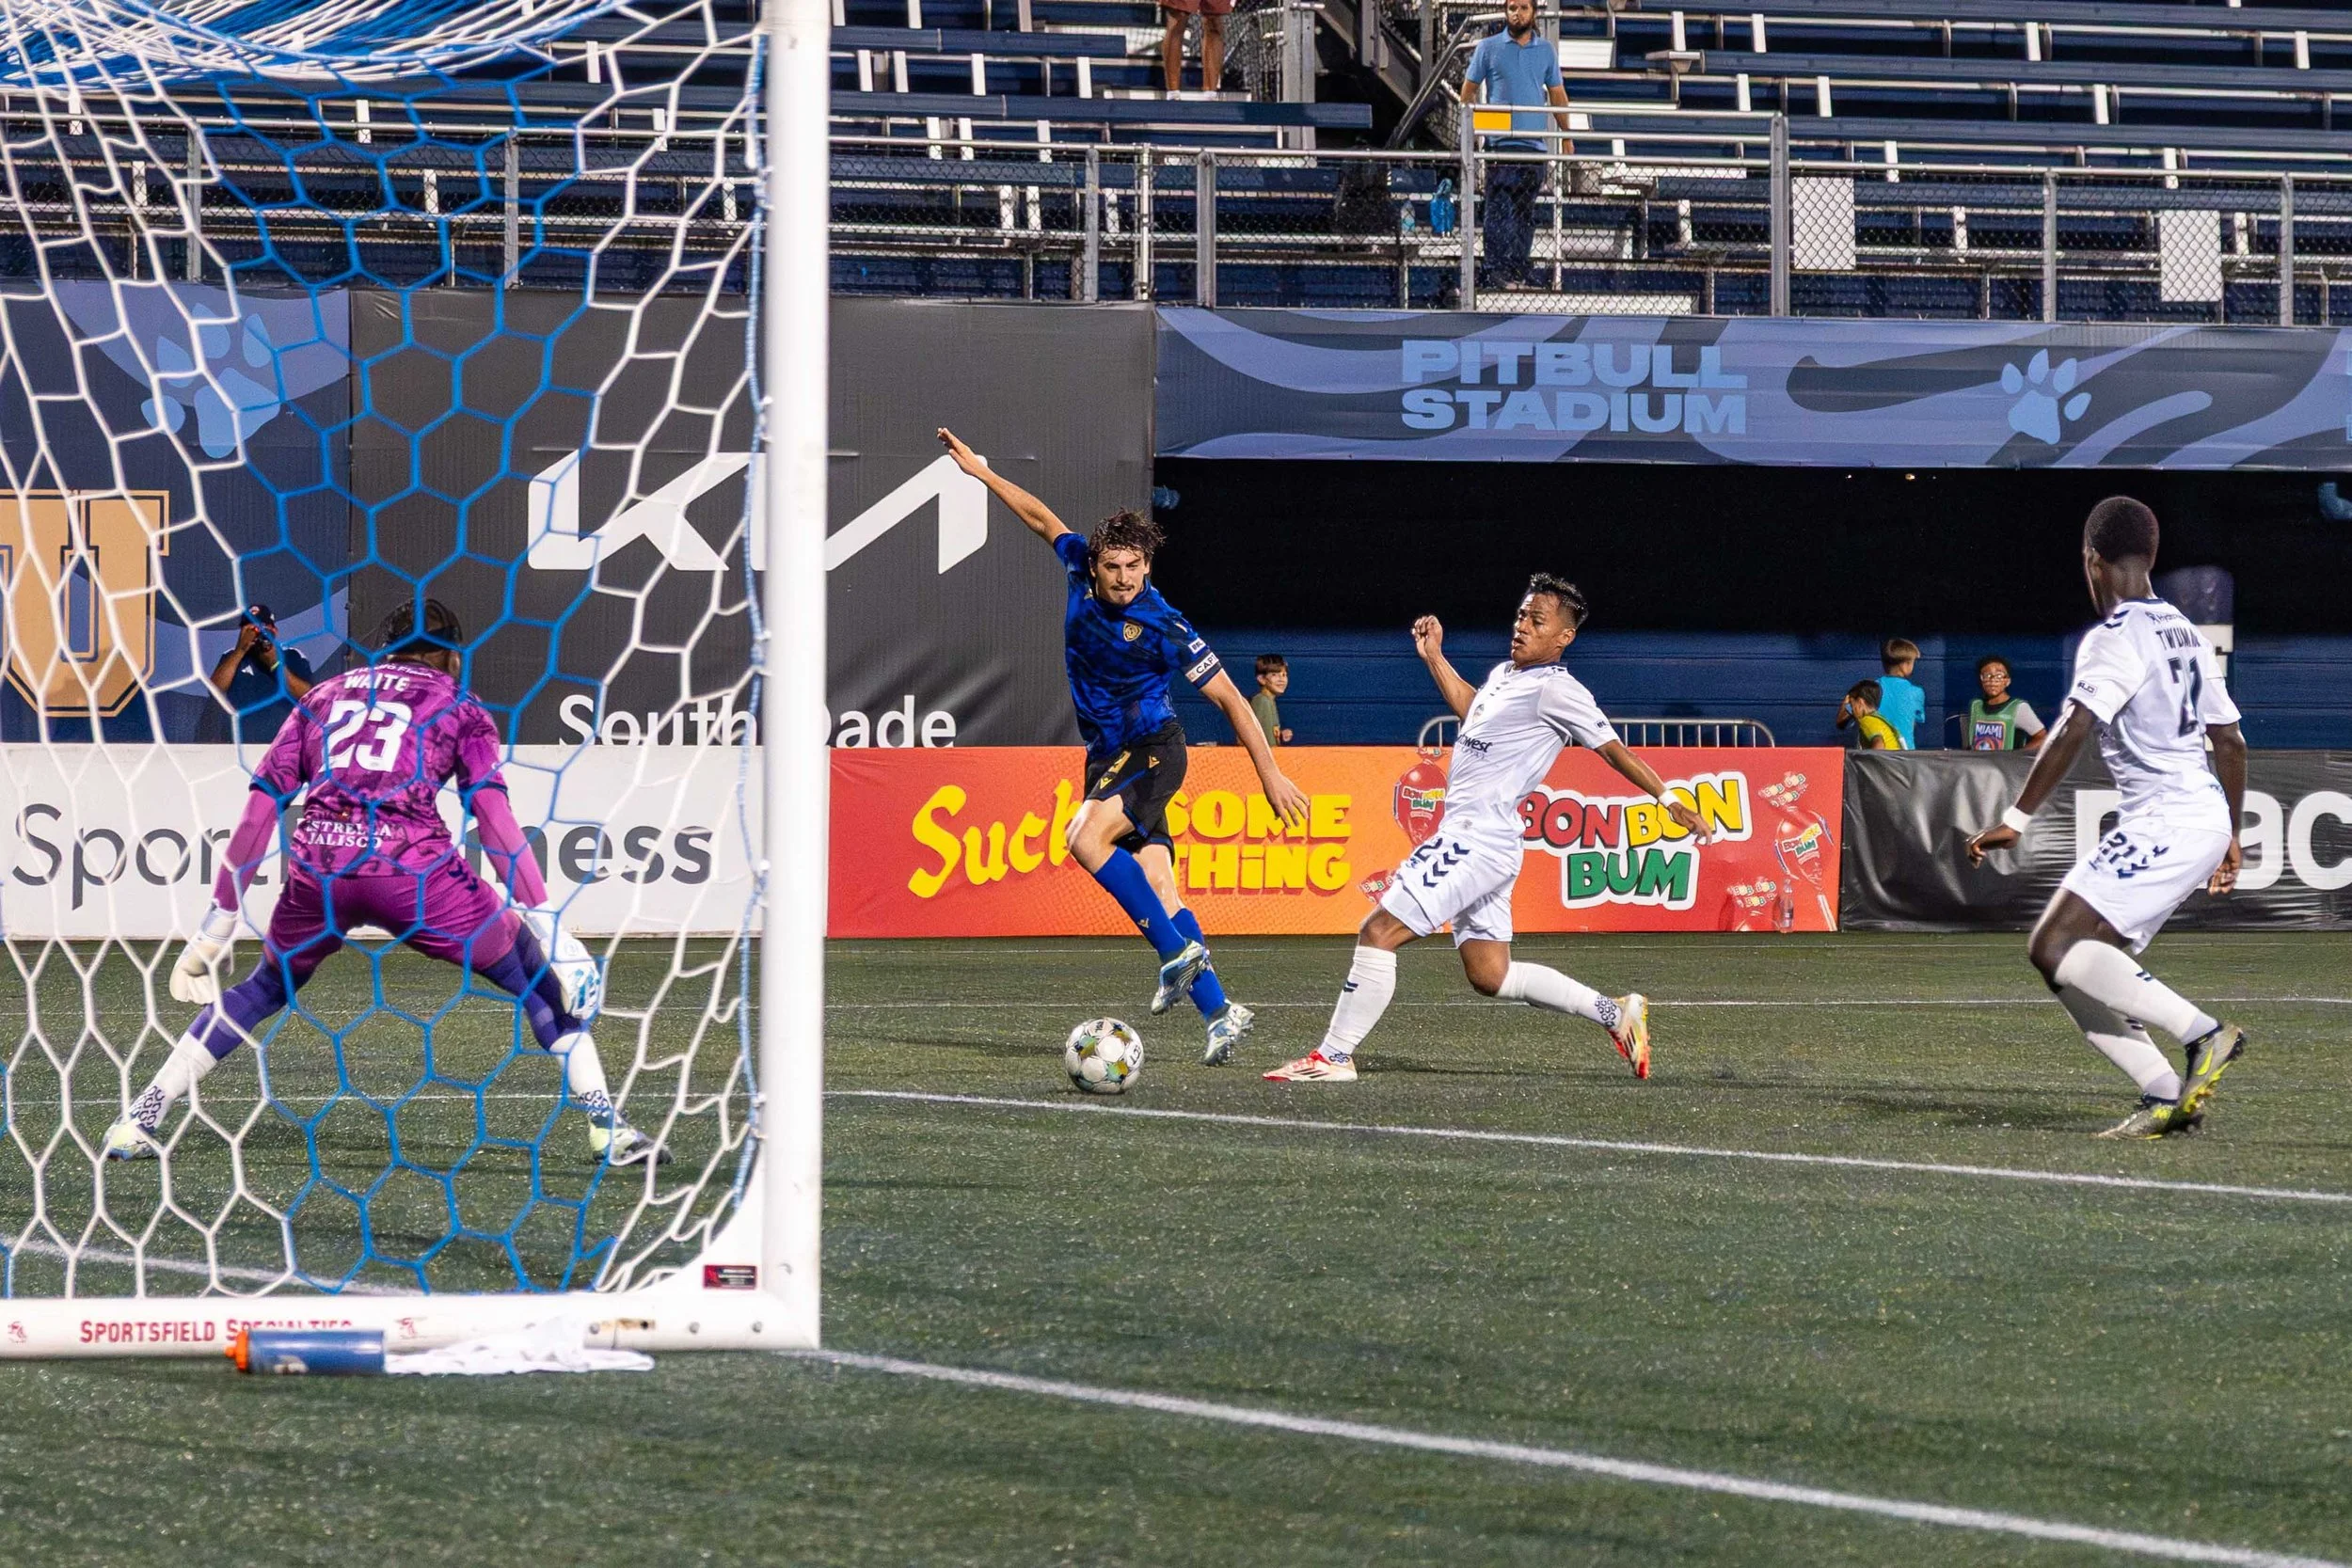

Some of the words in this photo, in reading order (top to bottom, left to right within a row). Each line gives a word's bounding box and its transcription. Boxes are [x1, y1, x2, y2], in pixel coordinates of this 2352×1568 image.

[1402, 340, 1748, 388] PITBULL
[1402, 389, 1747, 434] STADIUM
[344, 673, 410, 691] WAITE
[318, 700, 413, 772] 23
[559, 695, 757, 747] South
[824, 695, 957, 749] ade
[1518, 790, 1622, 848] BON
[1625, 779, 1743, 847] BON
[1568, 847, 1692, 900] BUM
[79, 1320, 215, 1344] SPORTSFIELD
